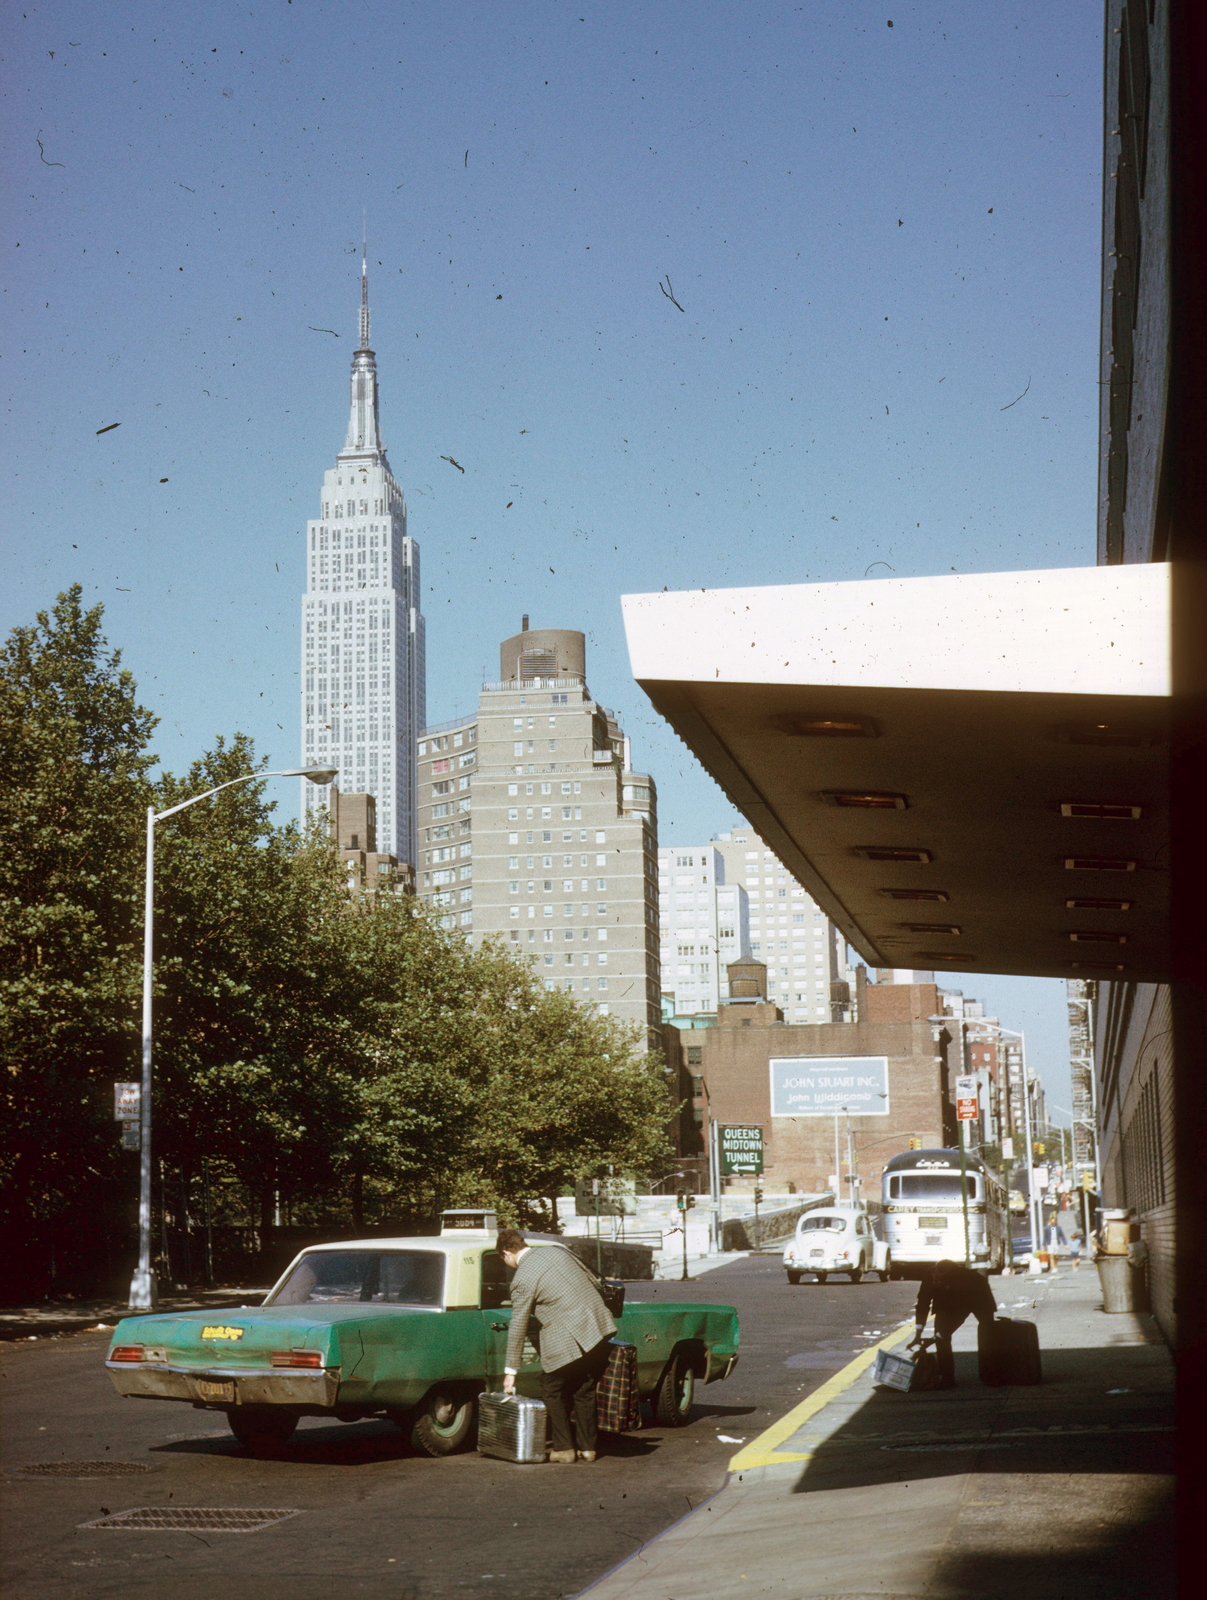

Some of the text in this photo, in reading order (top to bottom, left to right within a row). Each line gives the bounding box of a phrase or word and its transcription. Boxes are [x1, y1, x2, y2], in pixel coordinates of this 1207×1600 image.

[783, 1076, 880, 1088] JOHN STUART INC.
[814, 1092, 872, 1103] Widdicomb
[724, 1128, 760, 1139] QUEENS
[723, 1139, 762, 1150] MIDTOWN
[725, 1152, 761, 1163] TUNNEL
[887, 1205, 915, 1213] CAREY
[463, 1256, 475, 1265] 115
